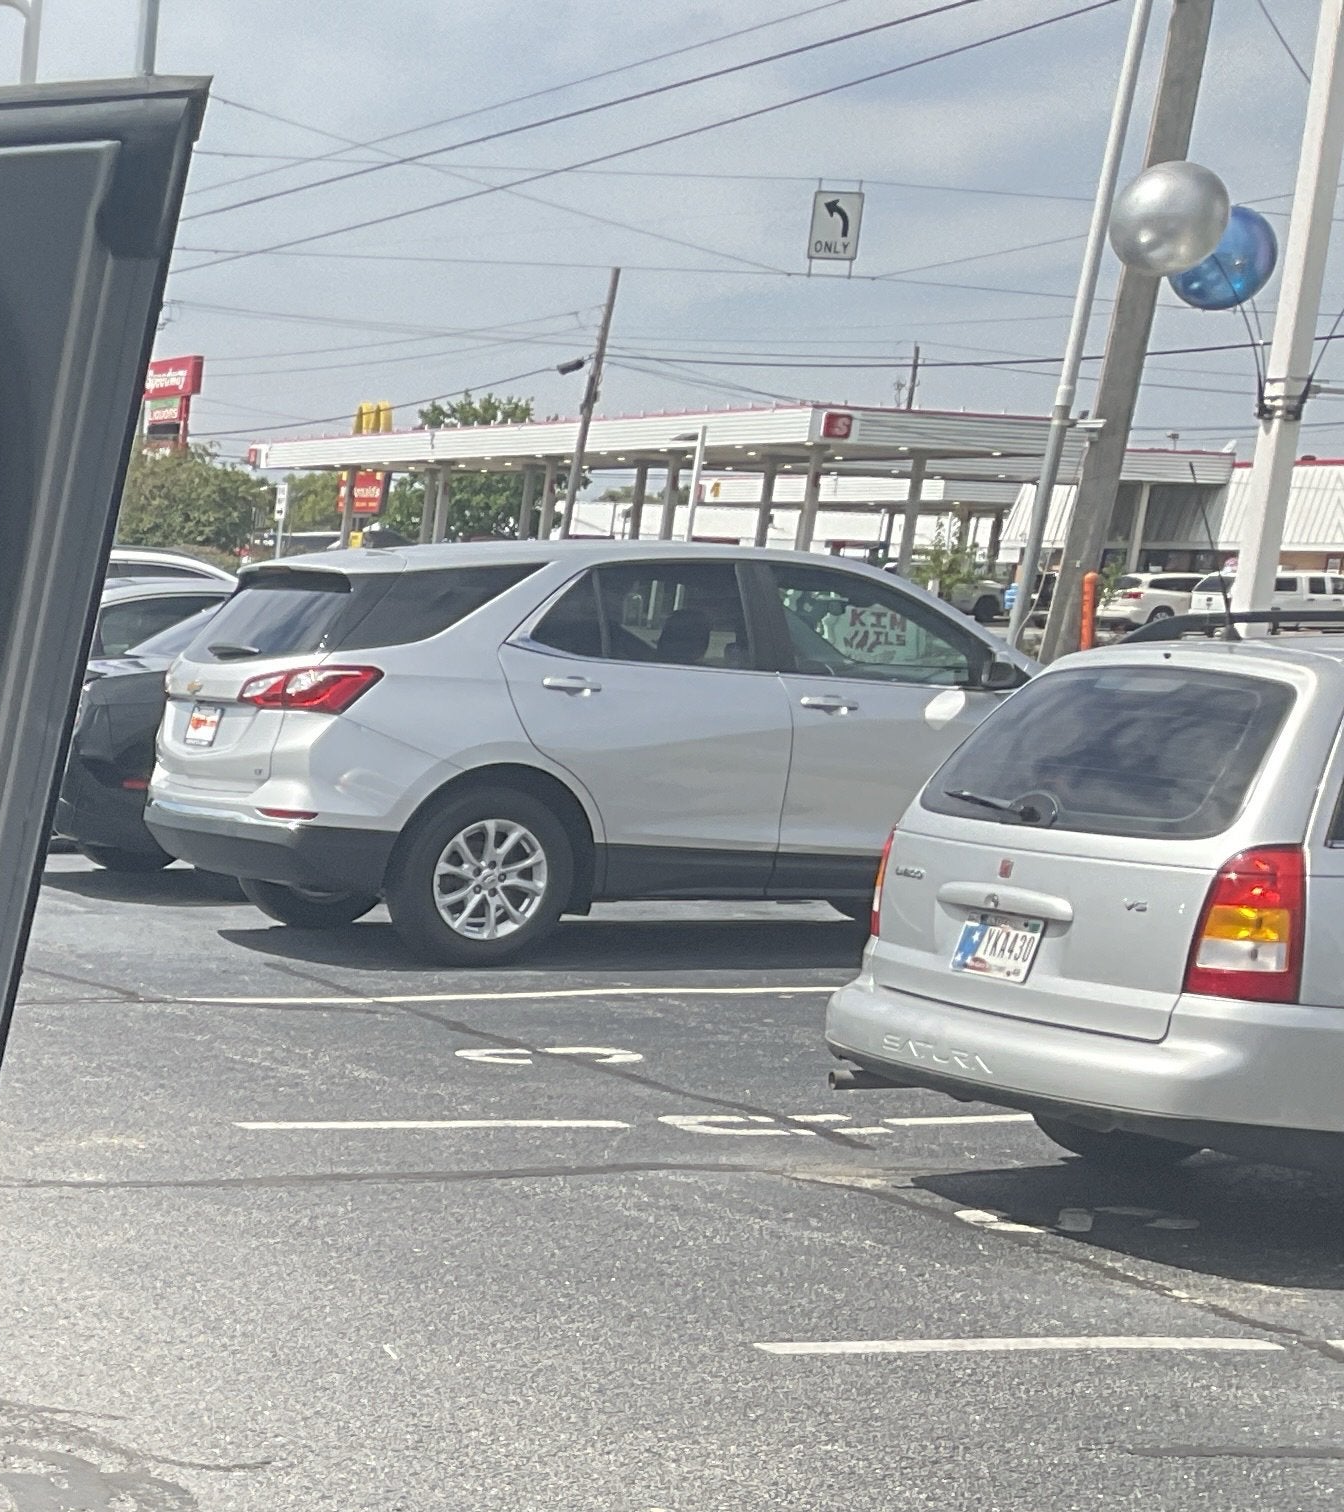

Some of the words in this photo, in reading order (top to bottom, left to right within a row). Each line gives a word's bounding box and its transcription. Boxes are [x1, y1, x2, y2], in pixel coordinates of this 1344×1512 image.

[814, 240, 850, 255] ONLY
[849, 608, 908, 632] KIM
[983, 928, 1036, 962] YKA430
